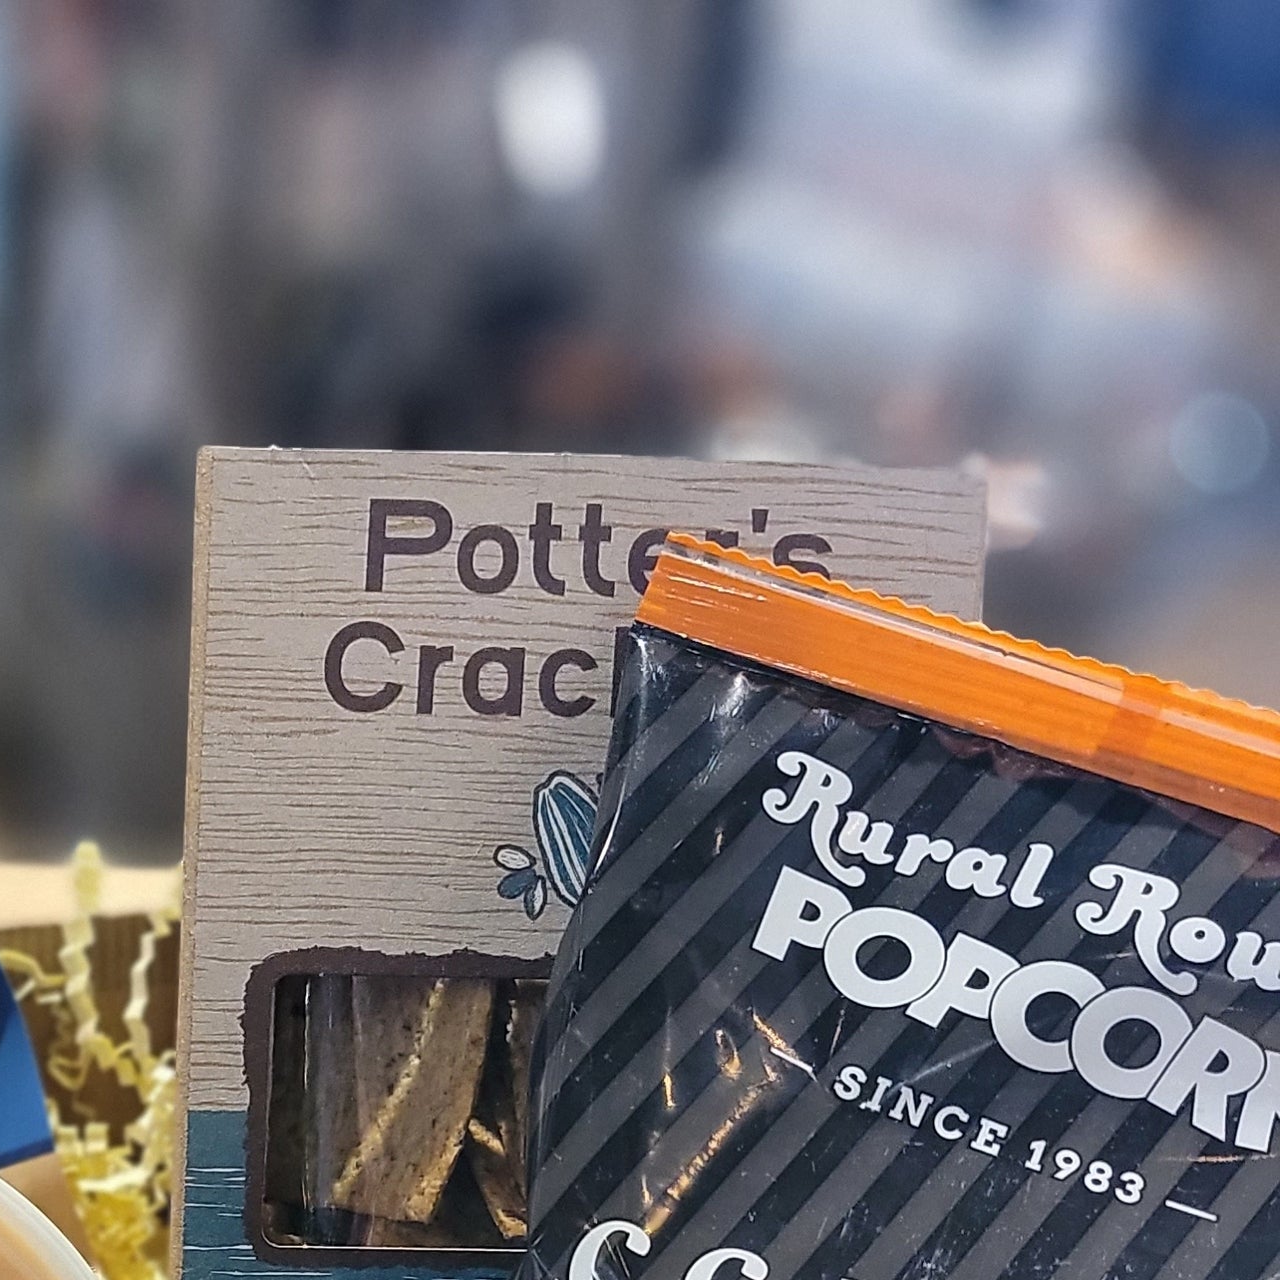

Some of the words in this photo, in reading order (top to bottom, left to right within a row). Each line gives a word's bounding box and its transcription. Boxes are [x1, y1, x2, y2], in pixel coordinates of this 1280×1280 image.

[325, 621, 628, 717] Crac
[762, 750, 1054, 908] Rural
[1074, 863, 1280, 996] Rou
[834, 1065, 1009, 1158] SINCE
[1025, 1139, 1146, 1205] 1983
